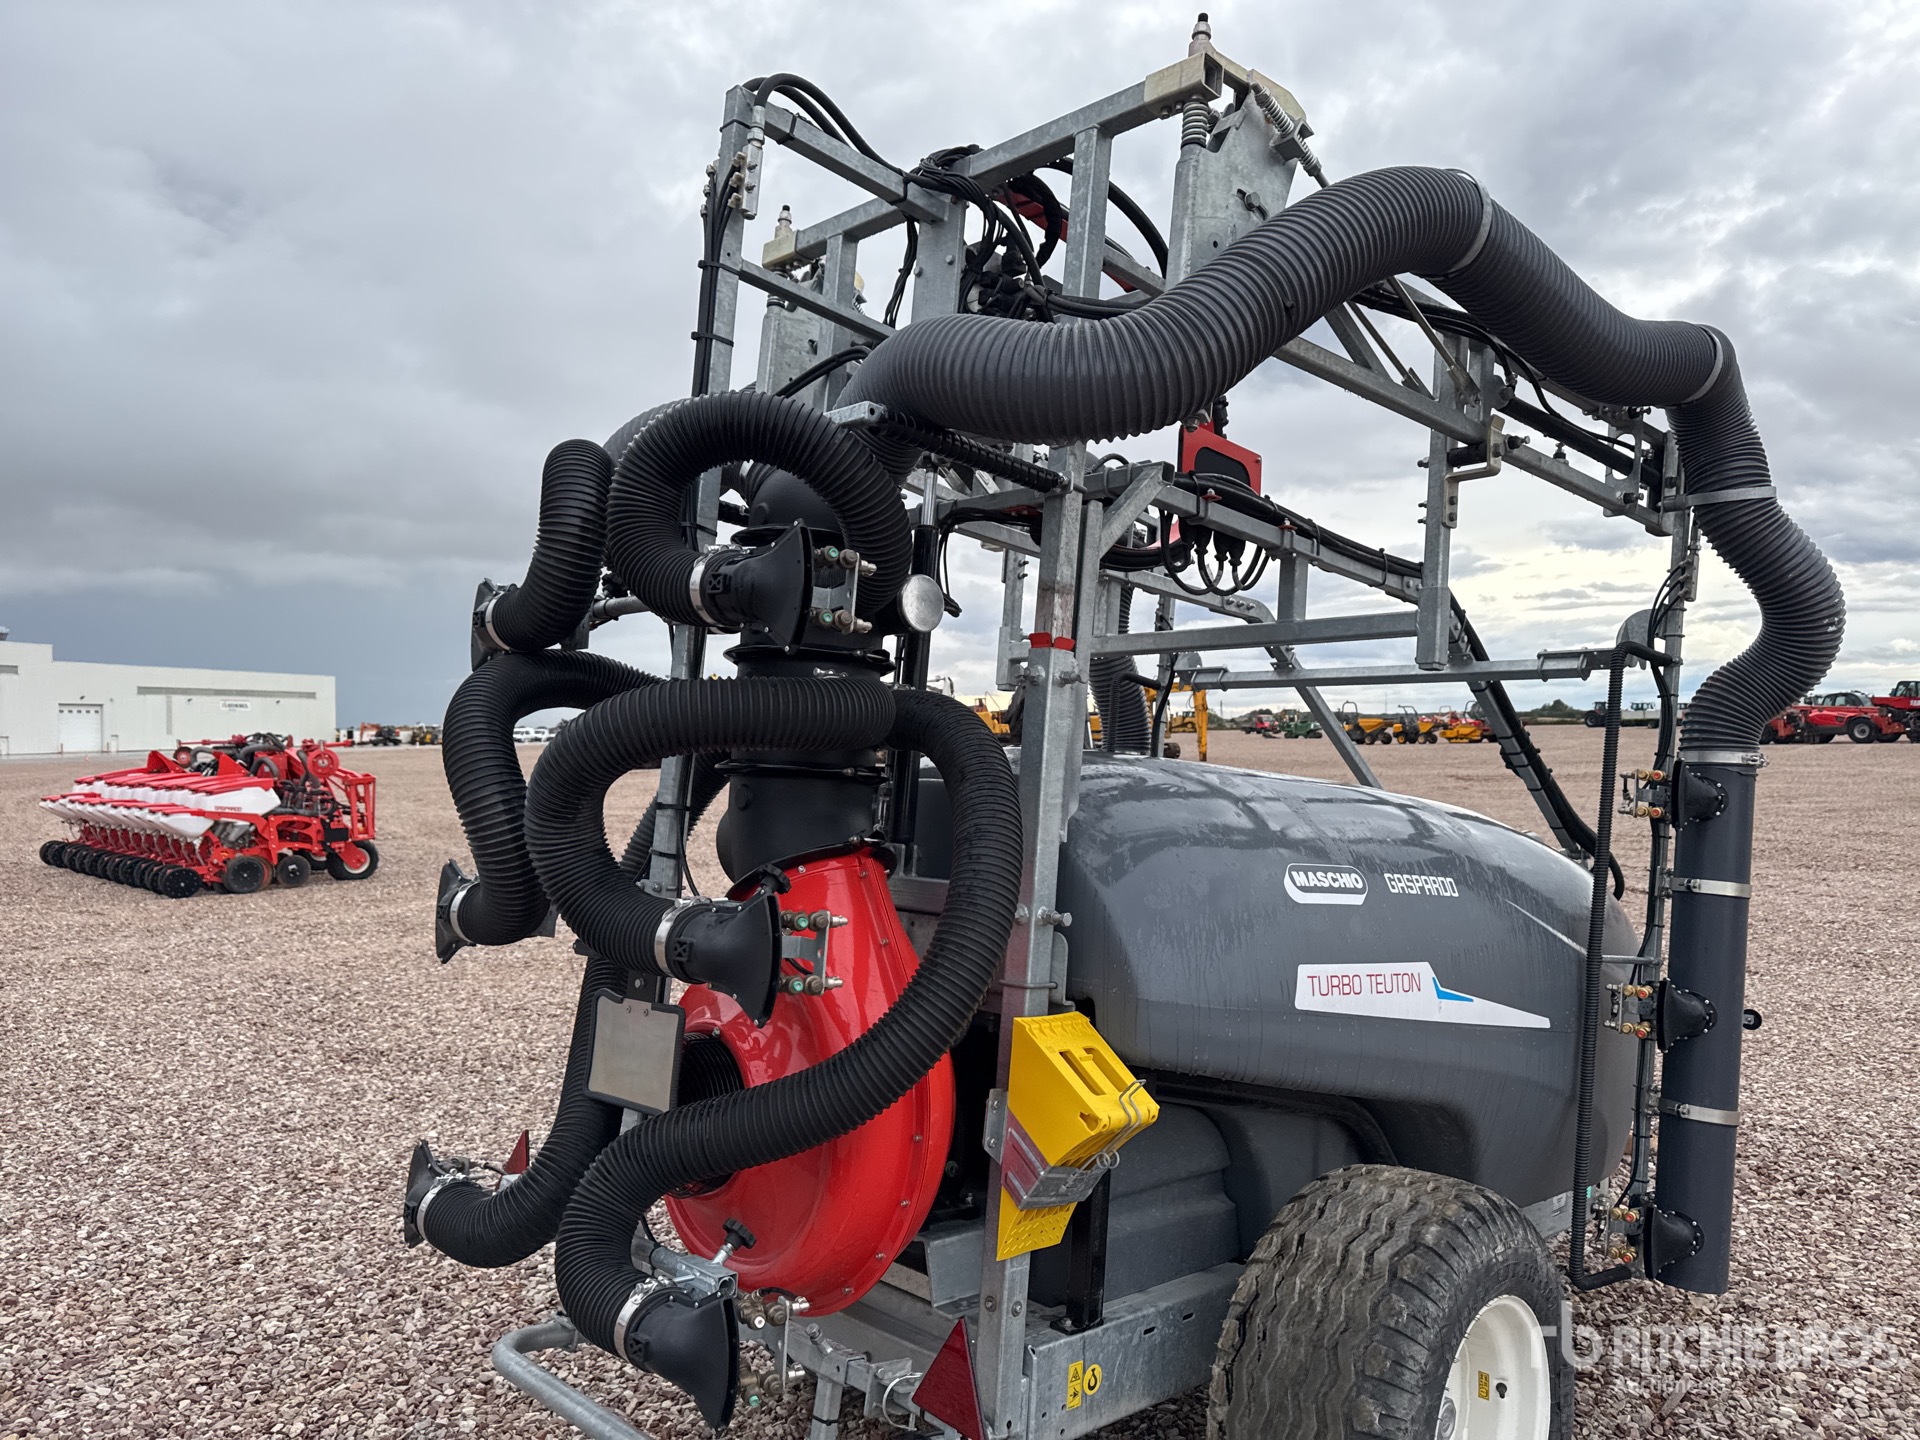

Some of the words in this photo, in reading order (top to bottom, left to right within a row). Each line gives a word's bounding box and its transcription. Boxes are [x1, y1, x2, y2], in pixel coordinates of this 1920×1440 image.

[1291, 871, 1364, 889] MASCHIO
[1383, 873, 1459, 898] GASPARDO
[1307, 974, 1363, 997] TURBO
[1366, 972, 1421, 994] TEUTON
